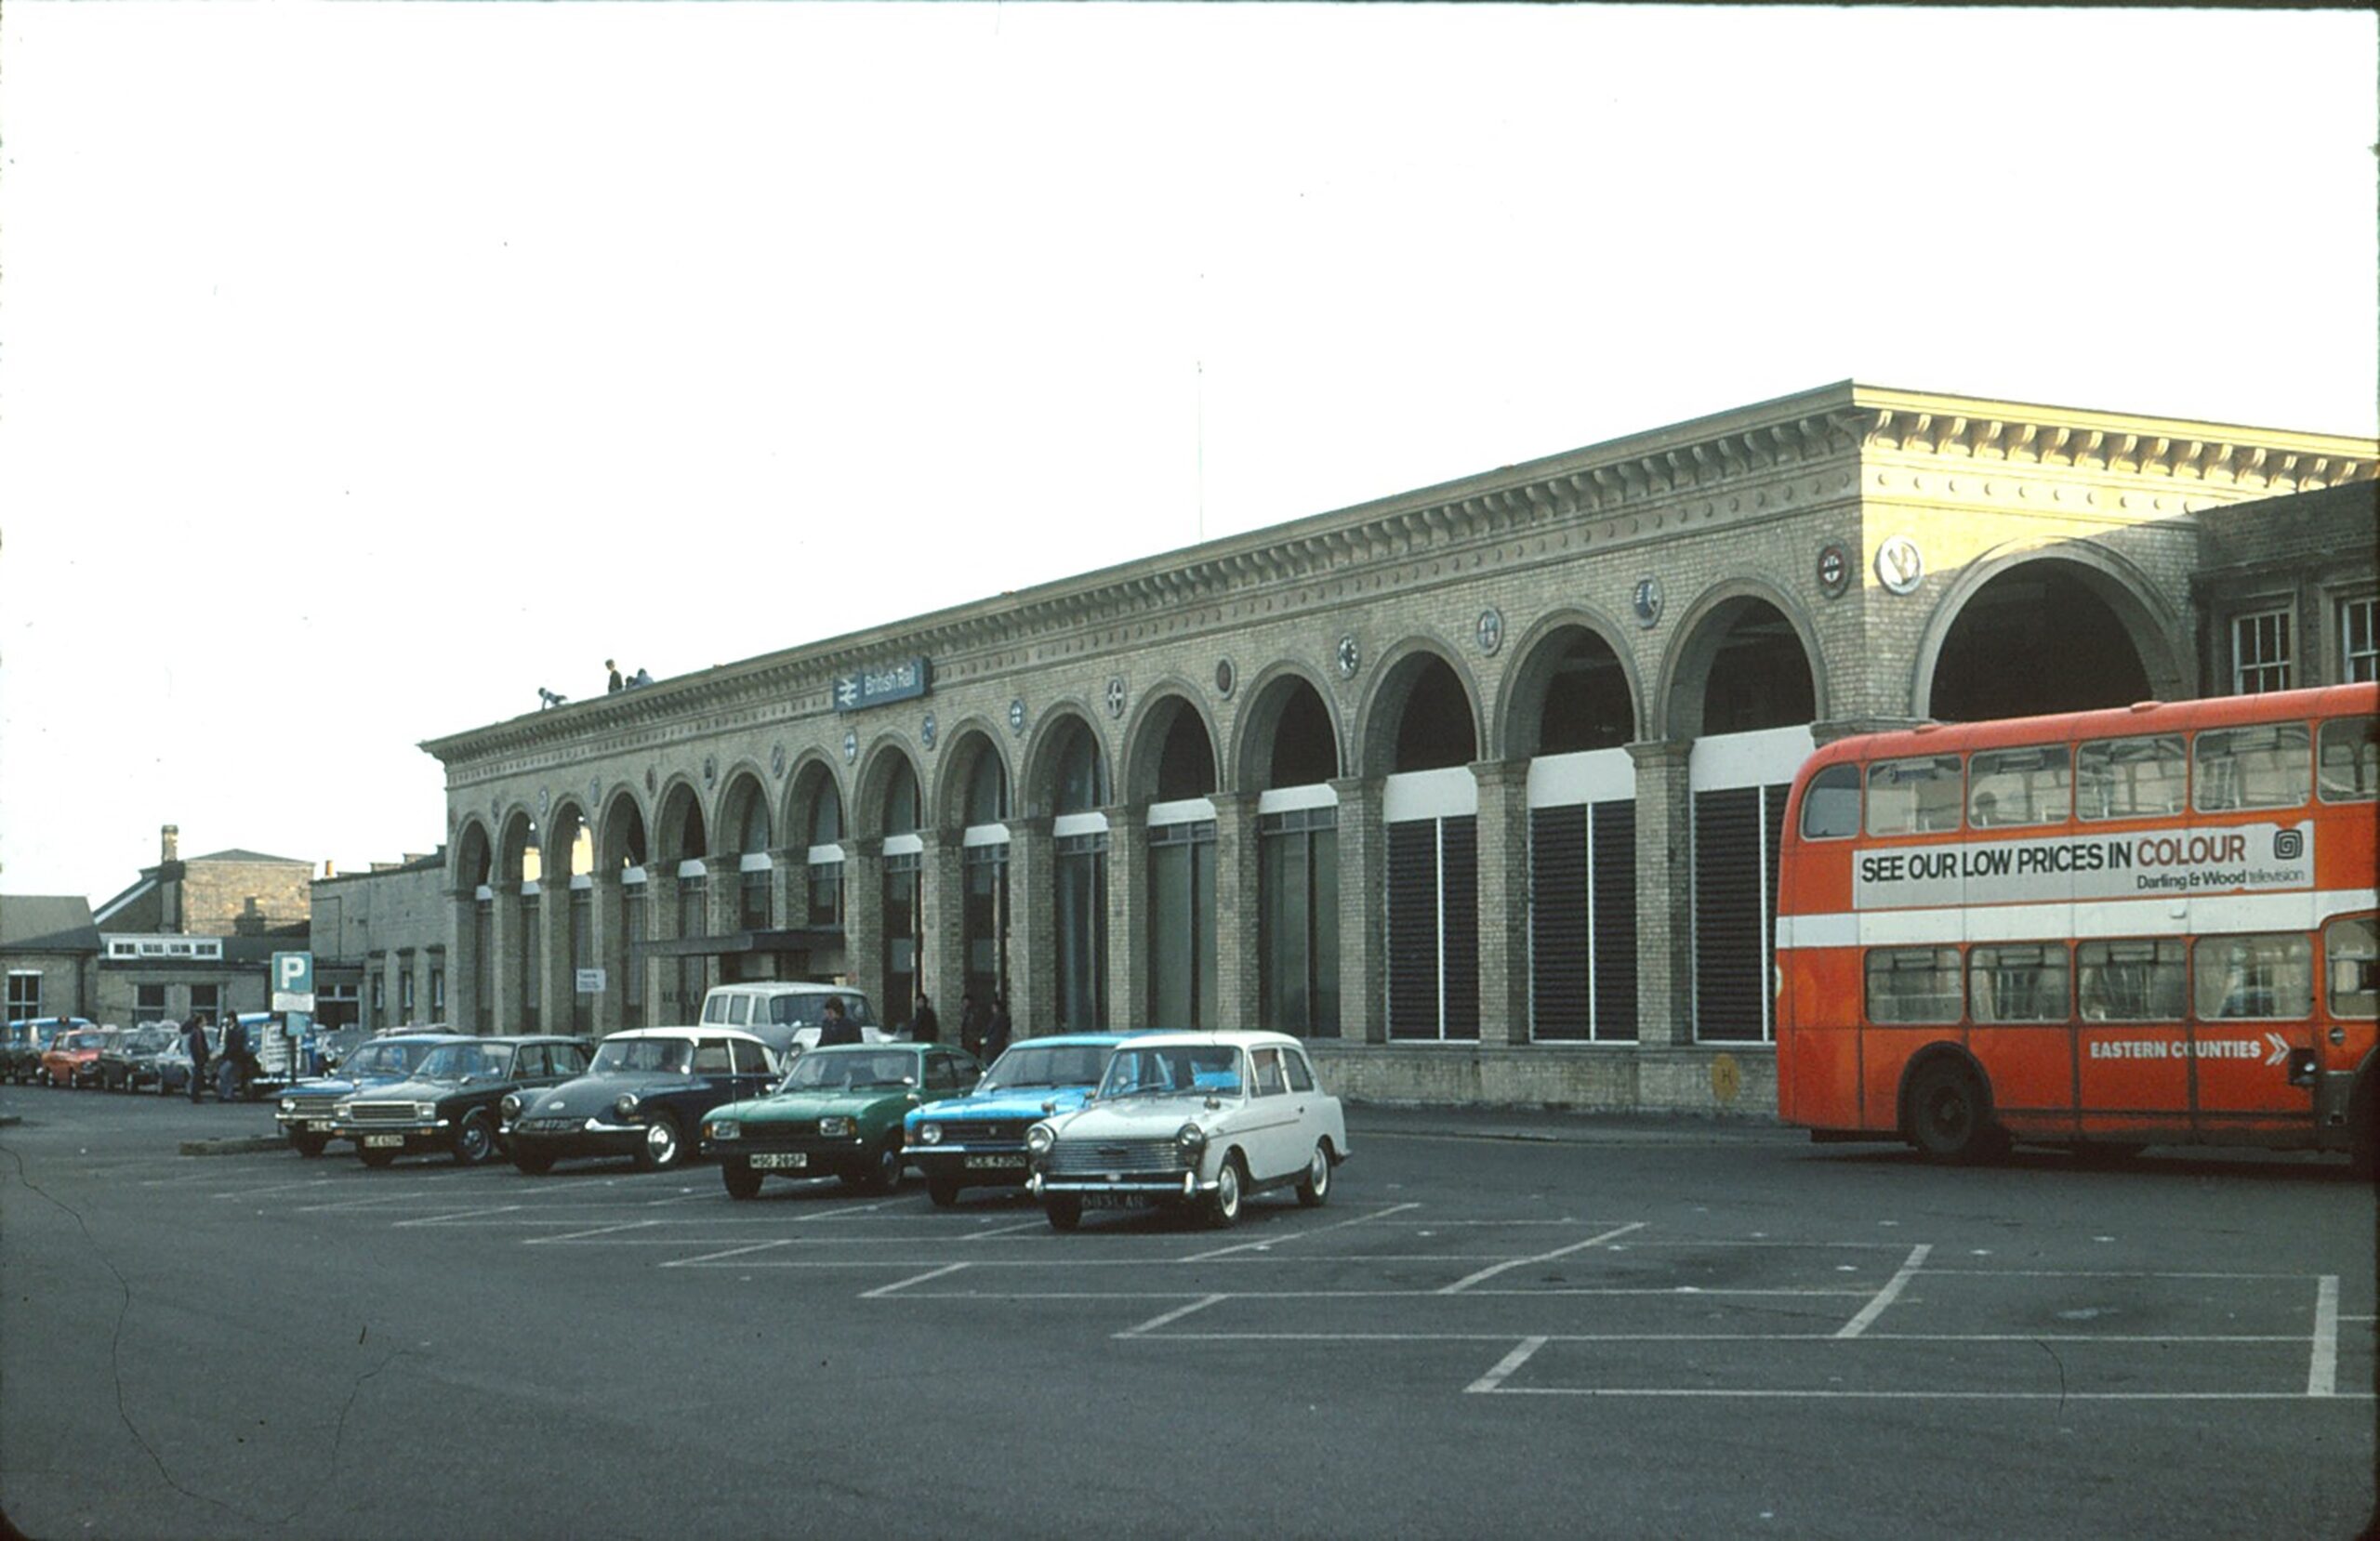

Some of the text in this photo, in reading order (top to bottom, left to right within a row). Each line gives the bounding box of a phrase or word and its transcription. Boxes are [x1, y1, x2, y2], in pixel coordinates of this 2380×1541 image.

[865, 665, 916, 695] British Rail
[1861, 835, 2246, 883] SEE OUR LOW PRICES IN COLOUR
[2188, 873, 2202, 887] &
[2202, 869, 2246, 886] Wood
[2248, 867, 2305, 883] television
[281, 956, 305, 989] P
[2090, 1041, 2167, 1059] EASTERN
